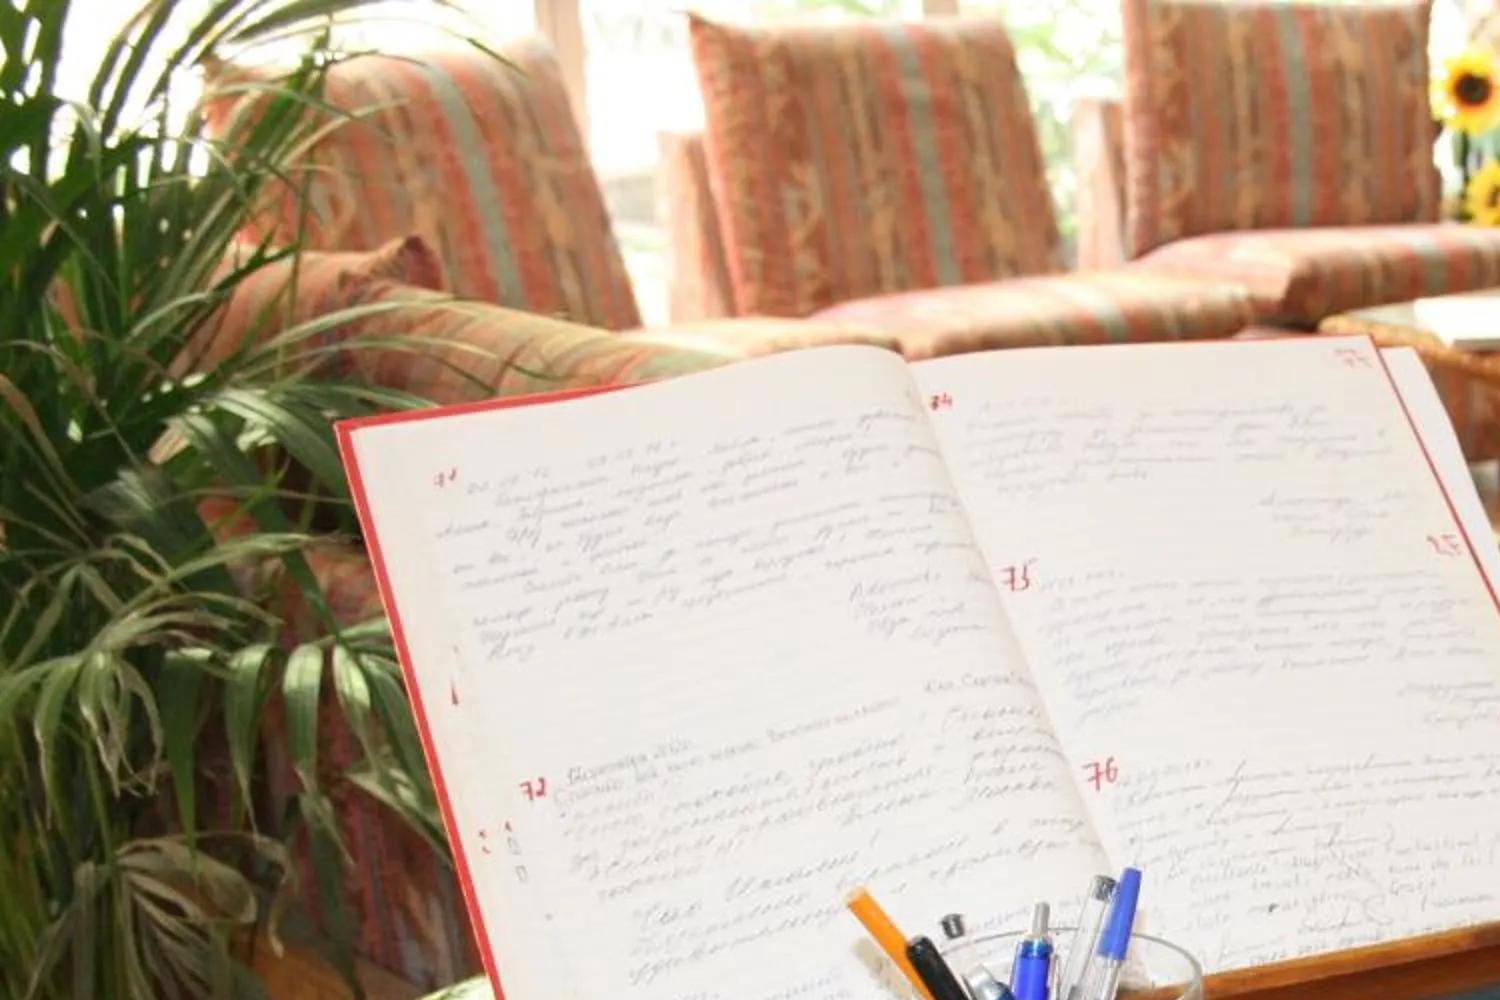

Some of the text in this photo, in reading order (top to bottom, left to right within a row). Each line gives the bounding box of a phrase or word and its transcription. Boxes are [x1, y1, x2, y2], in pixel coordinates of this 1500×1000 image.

[1000, 558, 1038, 592] 75
[519, 777, 547, 801] 72
[1082, 757, 1119, 791] 76
